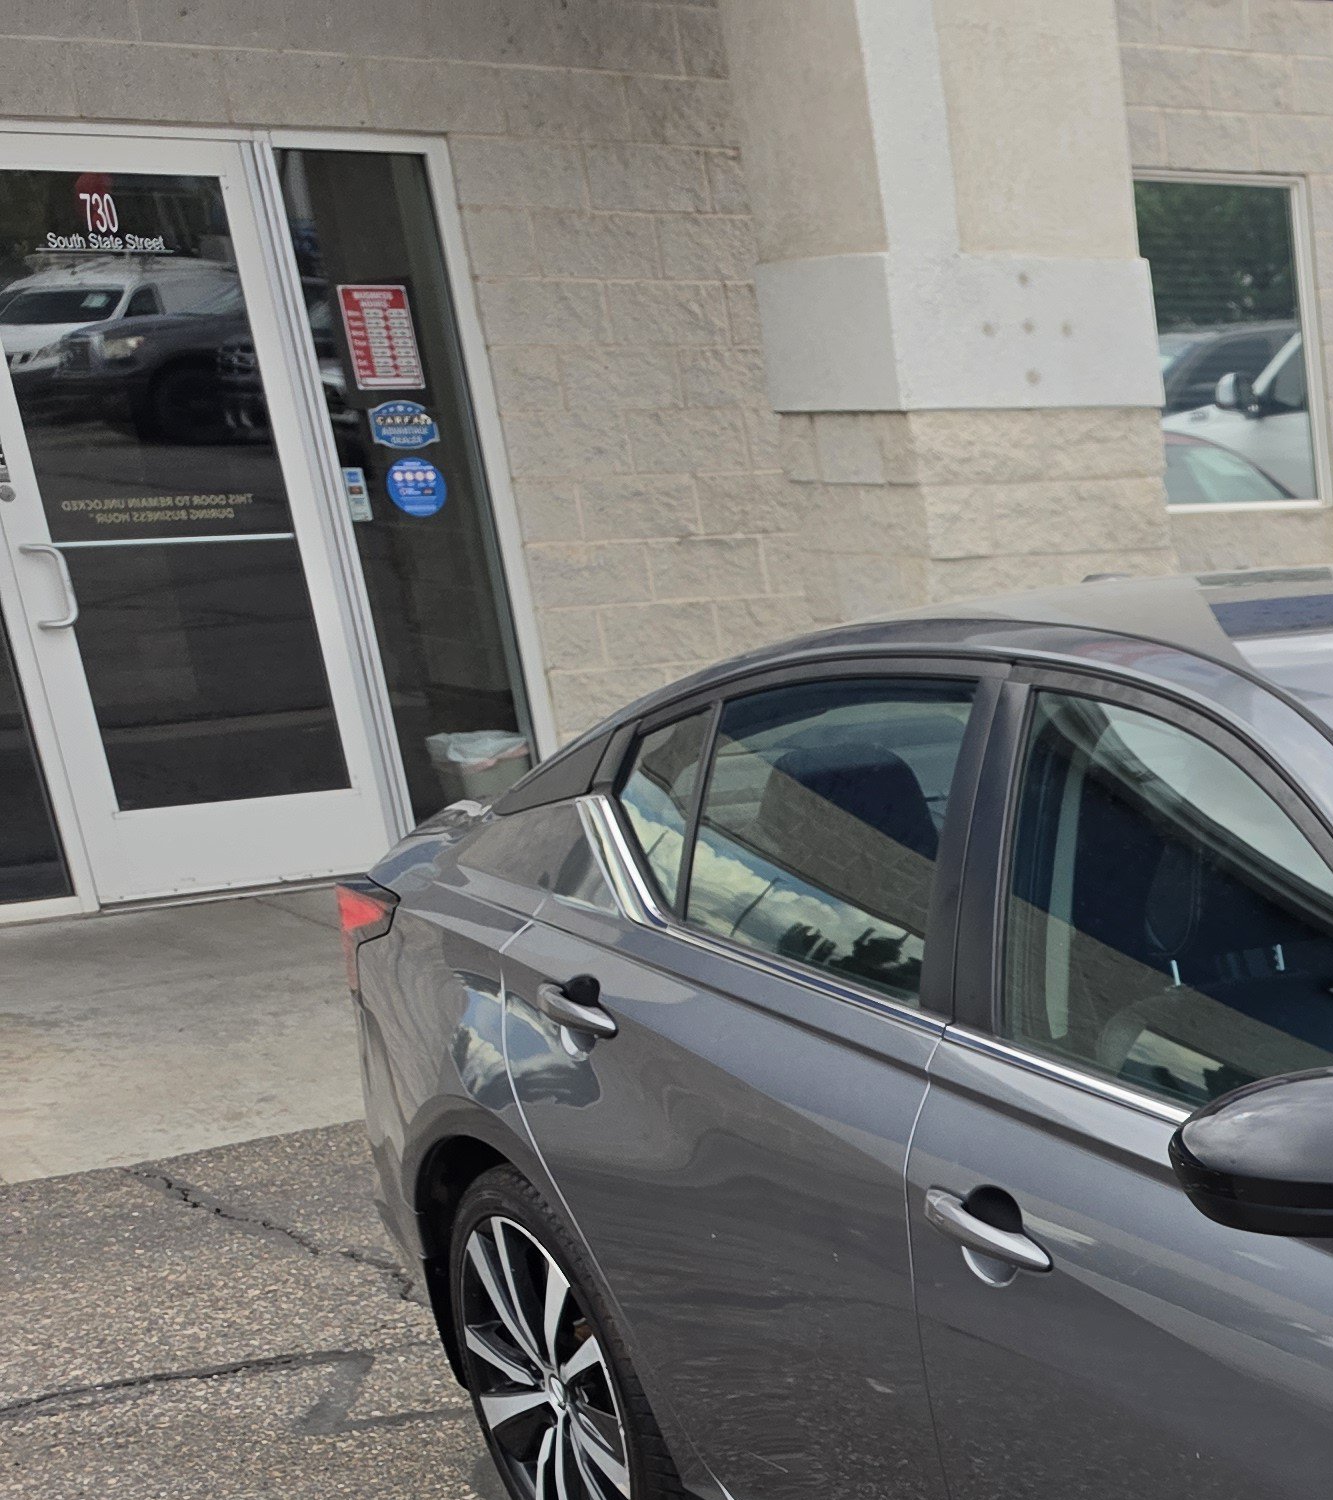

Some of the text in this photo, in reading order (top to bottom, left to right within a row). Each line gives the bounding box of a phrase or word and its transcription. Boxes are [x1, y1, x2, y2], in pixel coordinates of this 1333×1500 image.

[79, 193, 119, 233] 730
[46, 232, 166, 250] South State Street
